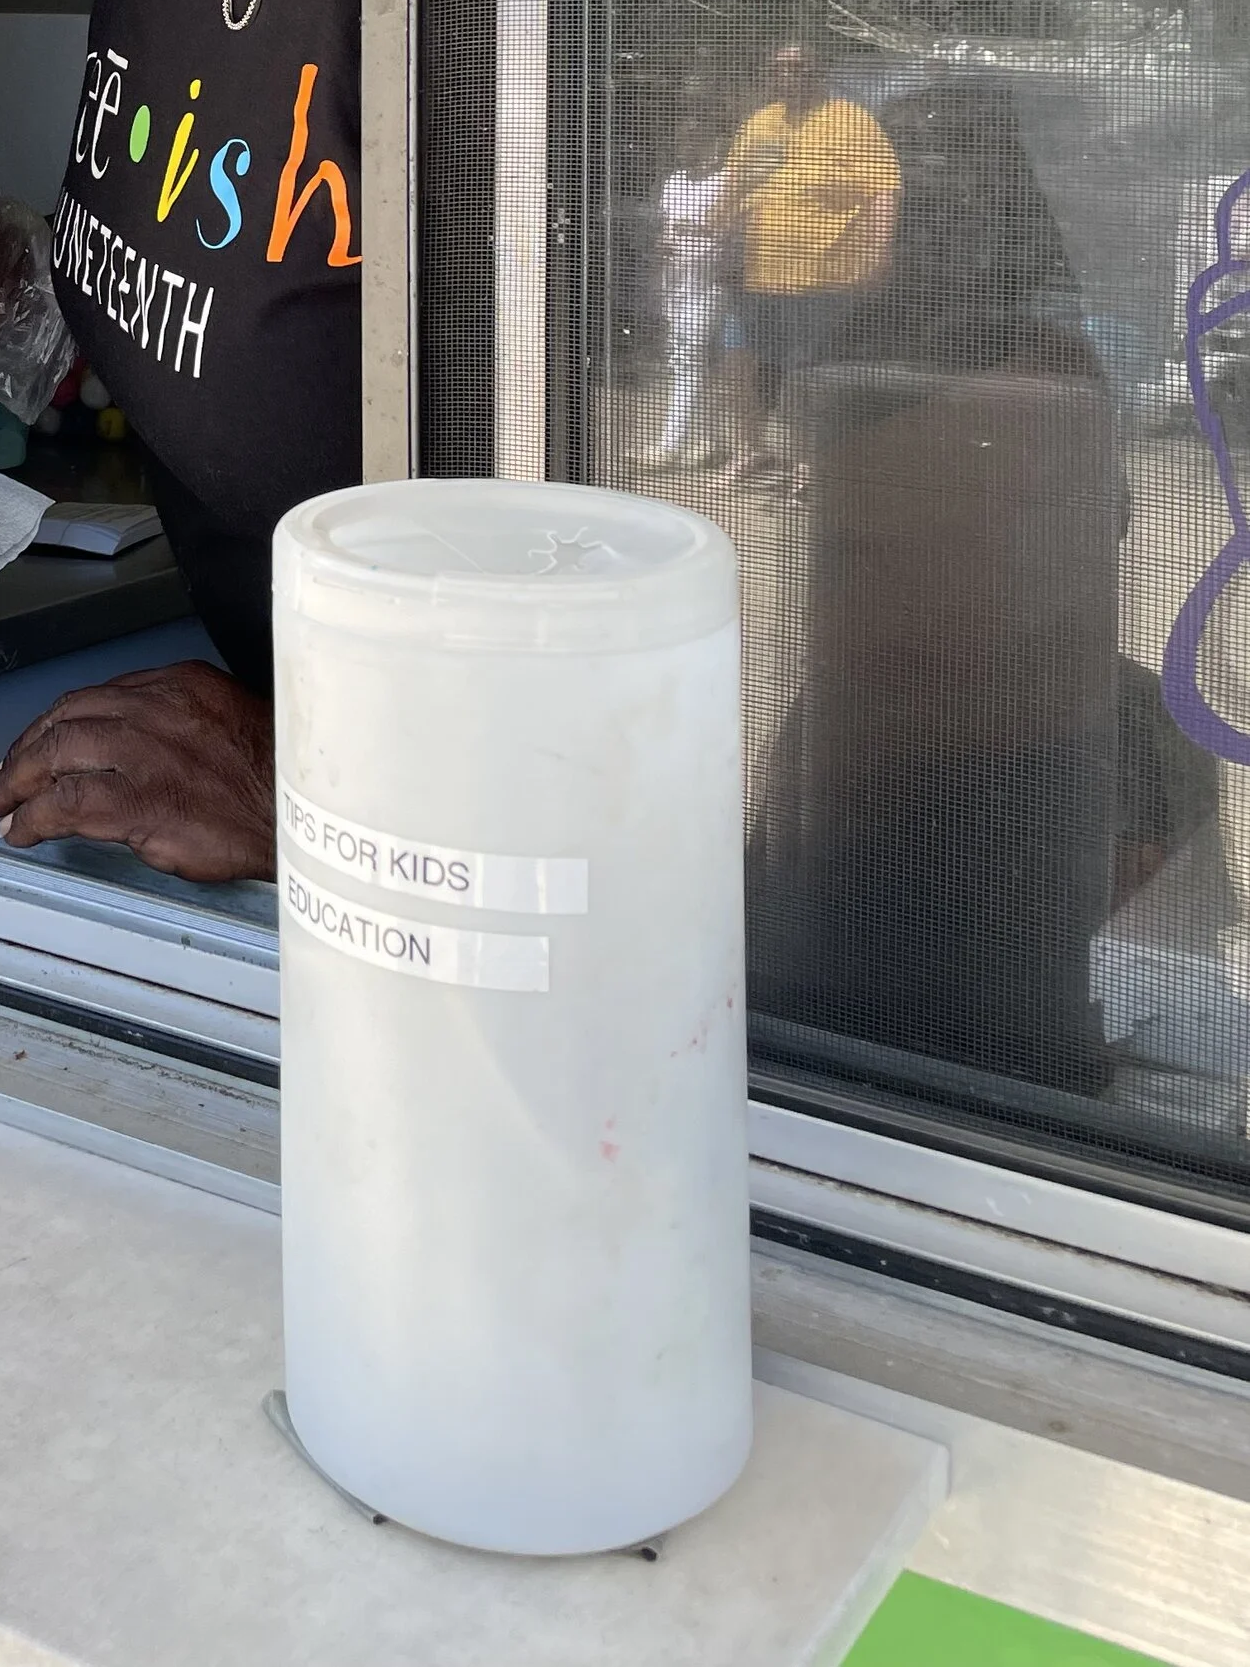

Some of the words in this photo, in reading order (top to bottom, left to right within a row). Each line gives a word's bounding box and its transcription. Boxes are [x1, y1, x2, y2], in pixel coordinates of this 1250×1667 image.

[52, 186, 214, 378] UNETEENTH
[283, 791, 317, 844] TIPS
[323, 822, 378, 872] FOR
[390, 848, 470, 891] KIDS
[288, 875, 430, 965] EDUCATION
